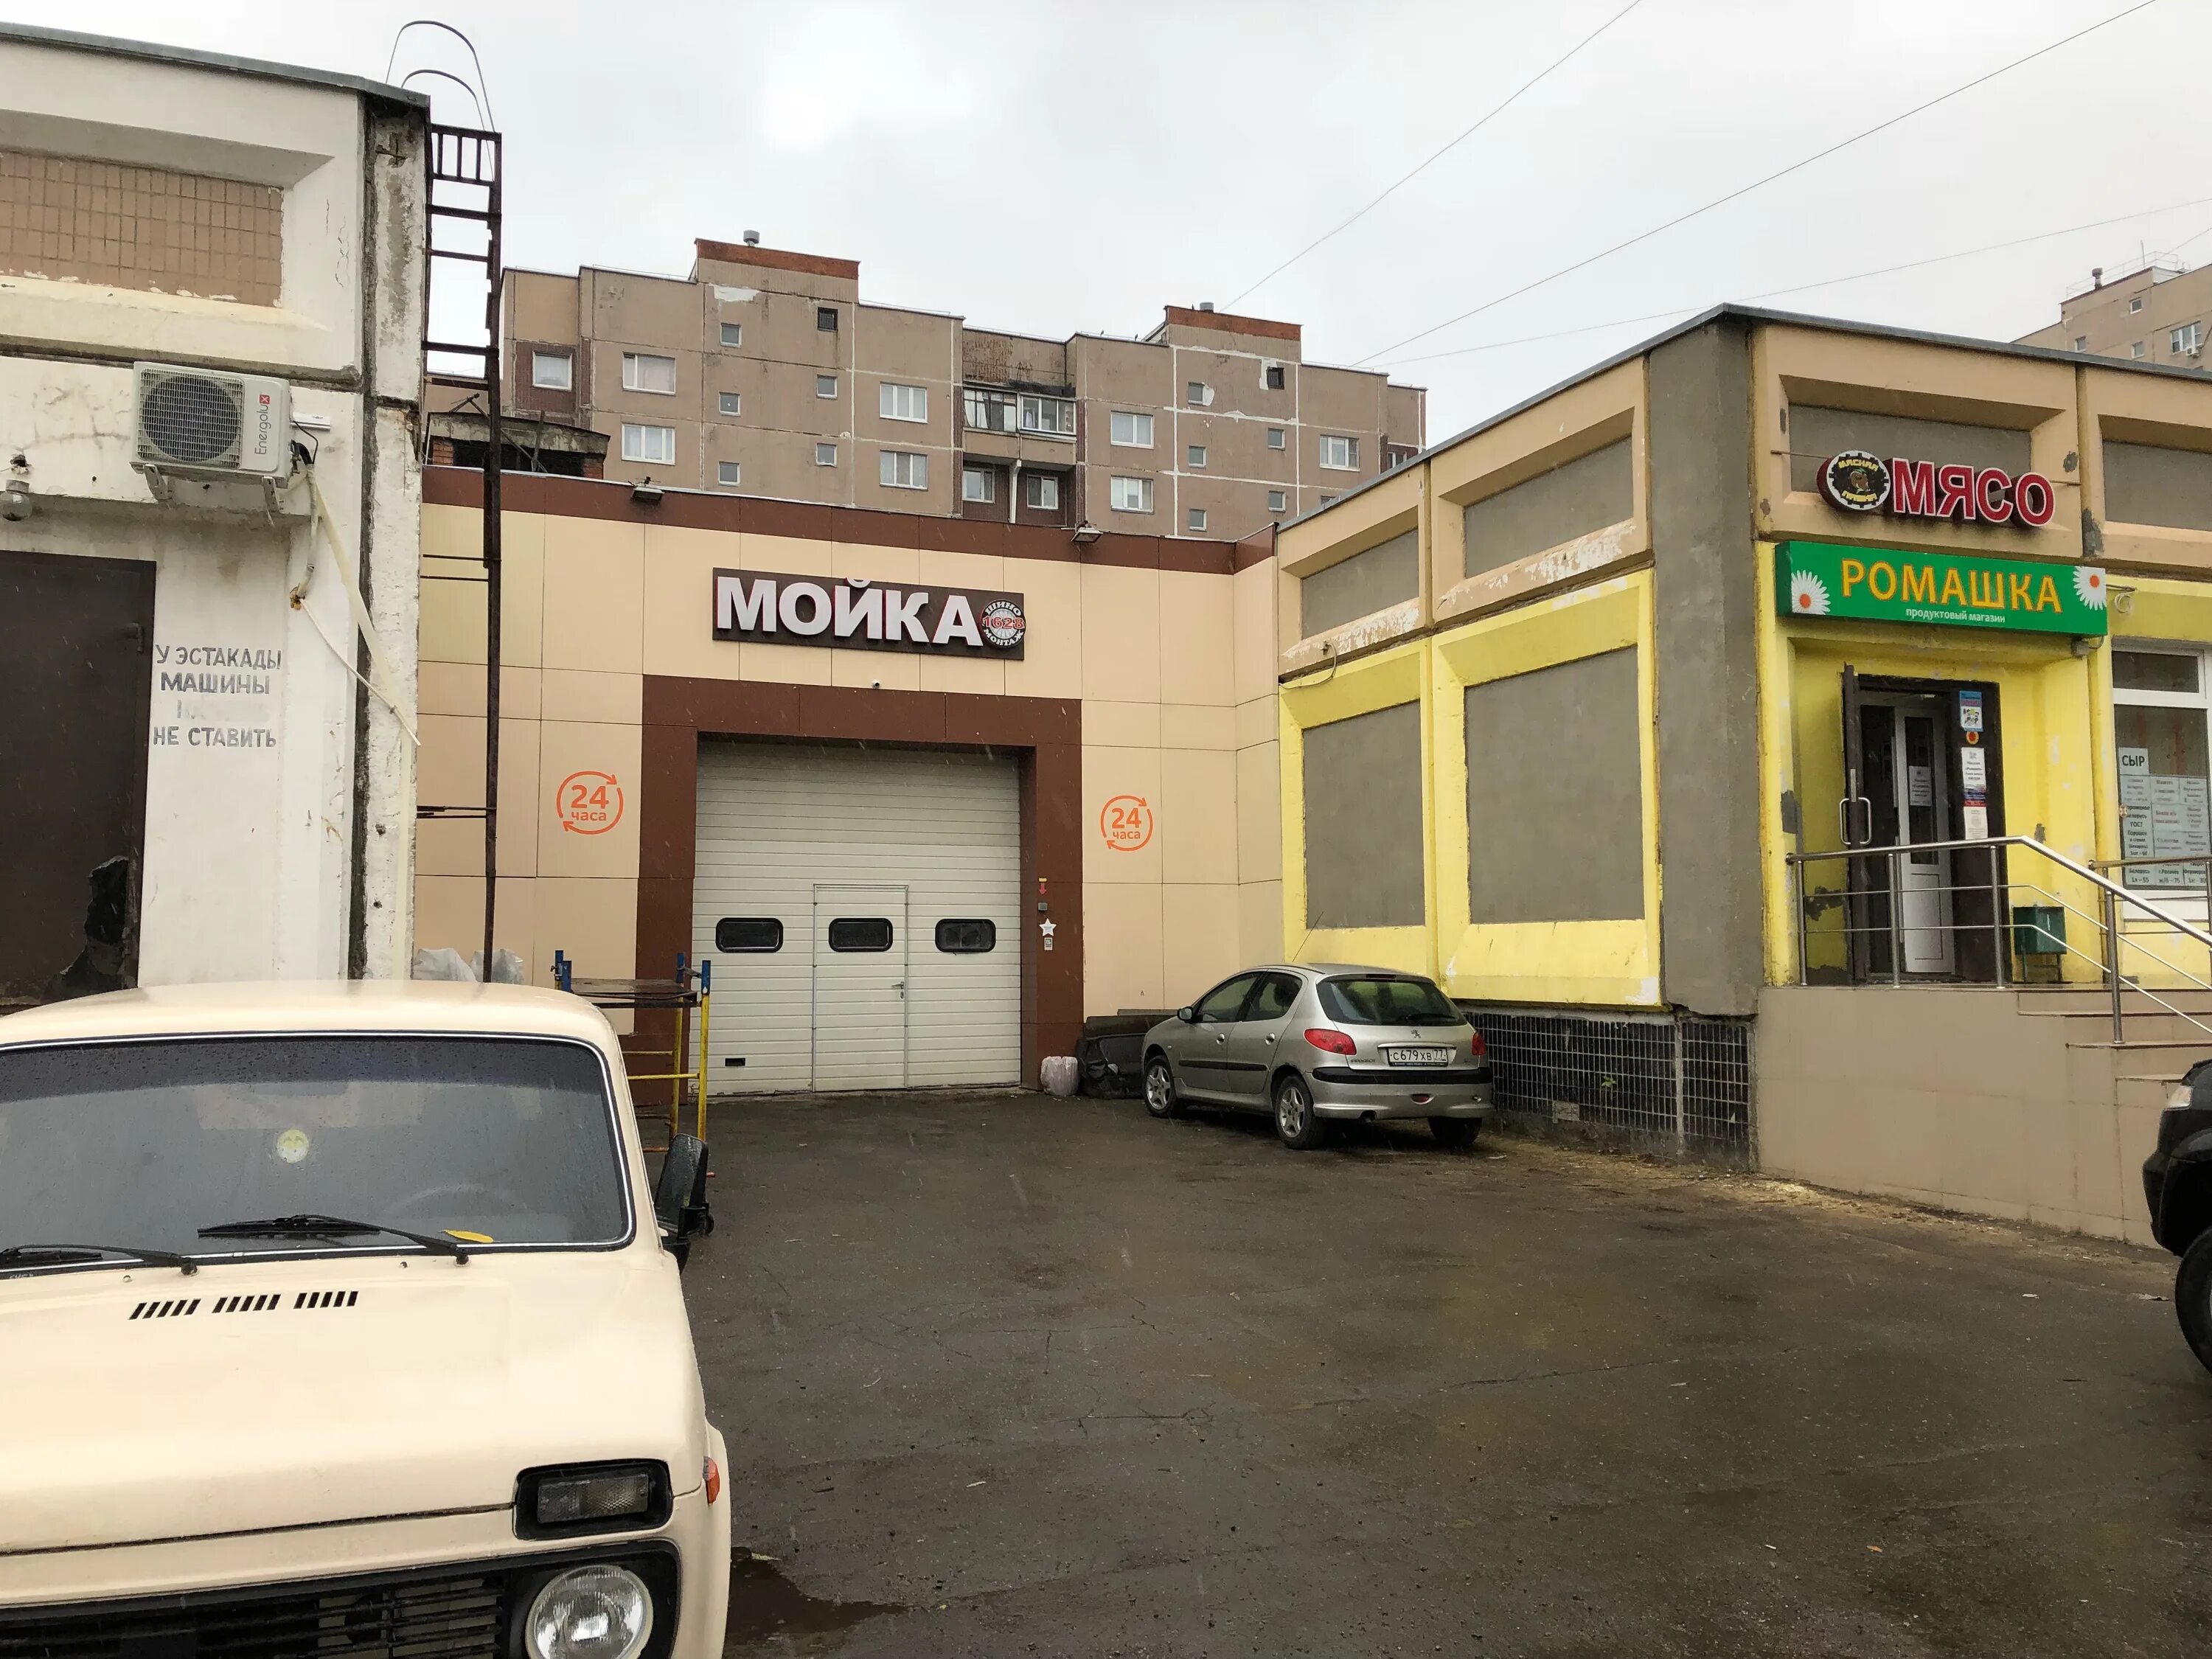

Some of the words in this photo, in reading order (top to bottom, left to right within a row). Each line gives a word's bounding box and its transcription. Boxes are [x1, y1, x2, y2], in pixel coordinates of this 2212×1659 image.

[254, 394, 271, 455] Energolux
[1892, 456, 2056, 527] МЯСО
[1840, 558, 2063, 614] РОМАШКА
[715, 575, 984, 647] МОЙКА
[984, 601, 1022, 616] ШИНО
[1905, 608, 1967, 620] продуктовый
[1969, 613, 2006, 623] магазин
[981, 615, 1026, 630] 1628
[983, 629, 1024, 647] МОНТАЖ
[155, 644, 170, 664] У
[175, 646, 282, 670] ЭСТАКАДЫ
[160, 672, 271, 695] МАШИНЫ
[153, 726, 180, 745] НЕ
[187, 726, 277, 748] СТАВИТЬ
[2121, 755, 2145, 767] СЫР
[571, 784, 610, 810] 24
[571, 811, 608, 821] часа
[1111, 807, 1142, 830] 24
[1113, 830, 1141, 840] часа
